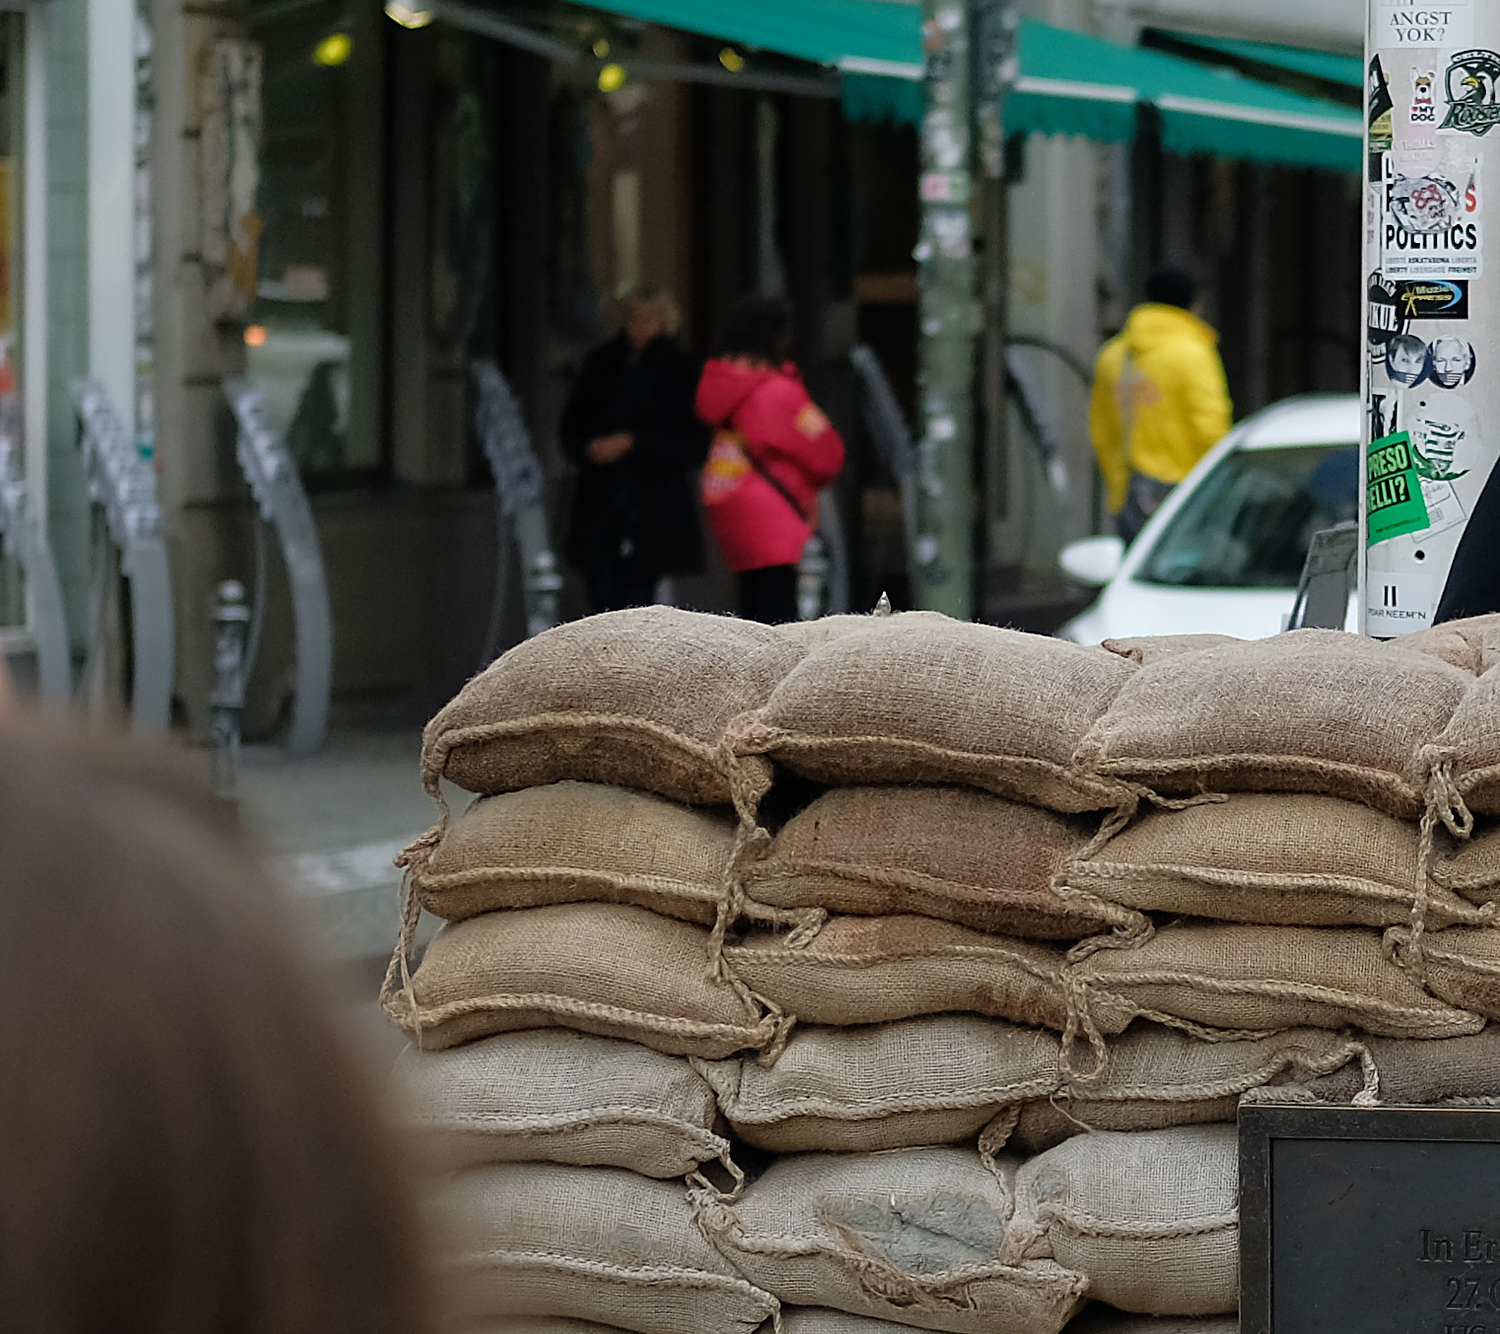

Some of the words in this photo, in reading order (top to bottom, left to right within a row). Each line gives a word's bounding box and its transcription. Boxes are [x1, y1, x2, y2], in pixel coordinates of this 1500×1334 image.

[1390, 11, 1453, 26] ANGST
[1395, 27, 1446, 42] YOK?
[1411, 114, 1436, 122] DOG
[1418, 1228, 1451, 1264] In
